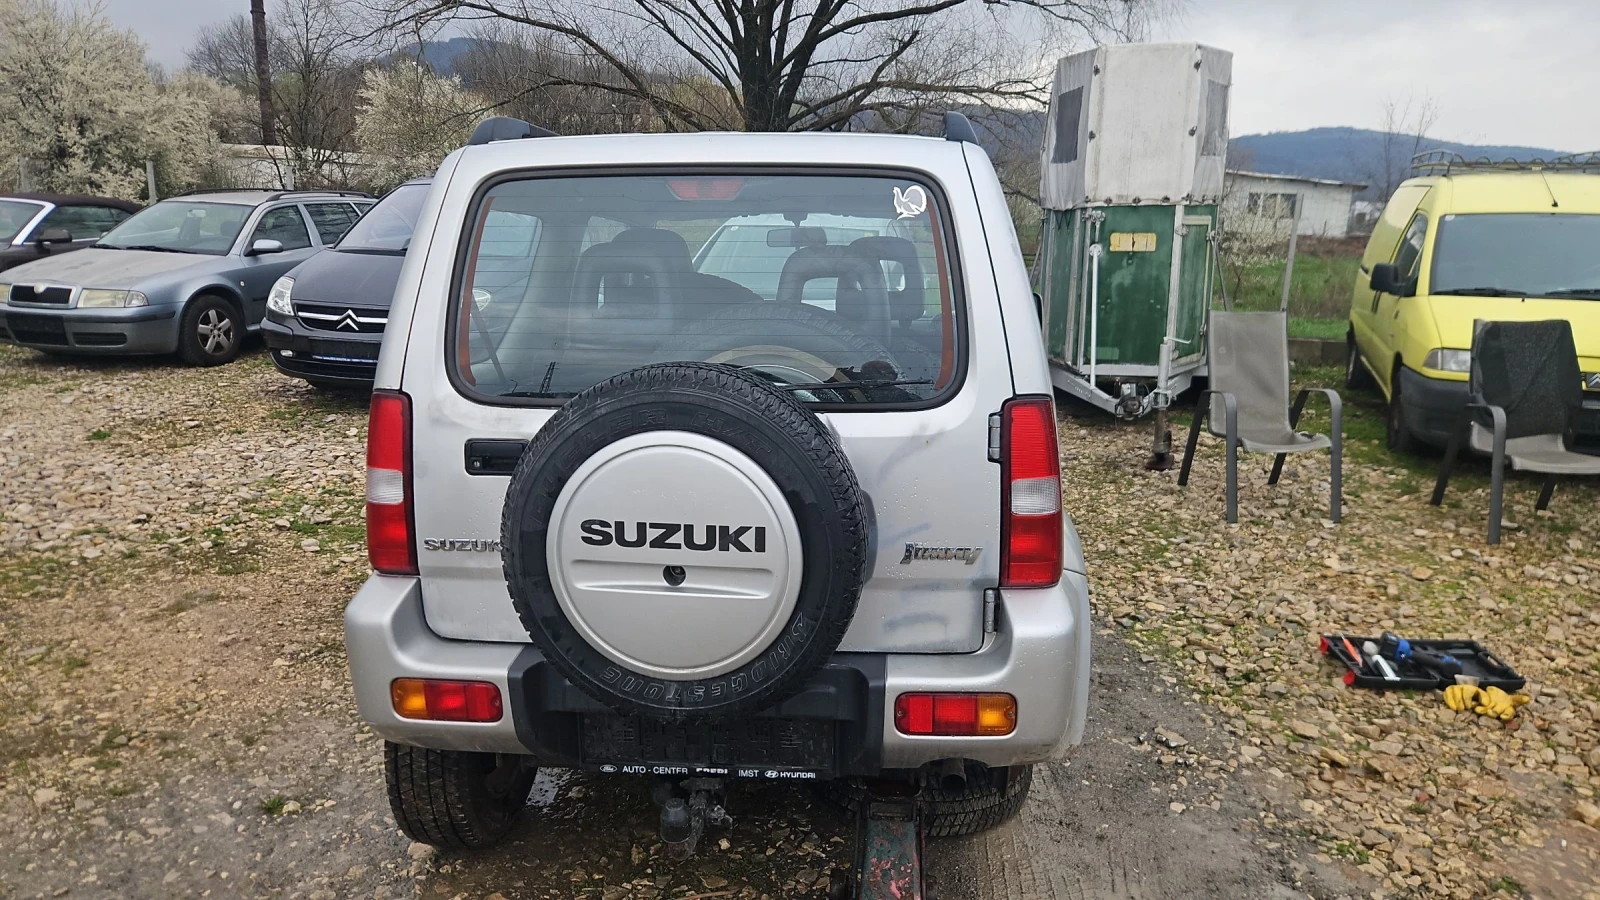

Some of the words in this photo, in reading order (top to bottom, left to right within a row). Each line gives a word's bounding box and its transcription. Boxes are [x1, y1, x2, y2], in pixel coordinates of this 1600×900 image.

[423, 537, 503, 552] SUZUK
[580, 519, 766, 553] SUZUKI
[599, 611, 814, 703] BRIDGESTONE
[622, 765, 647, 774] AUTO
